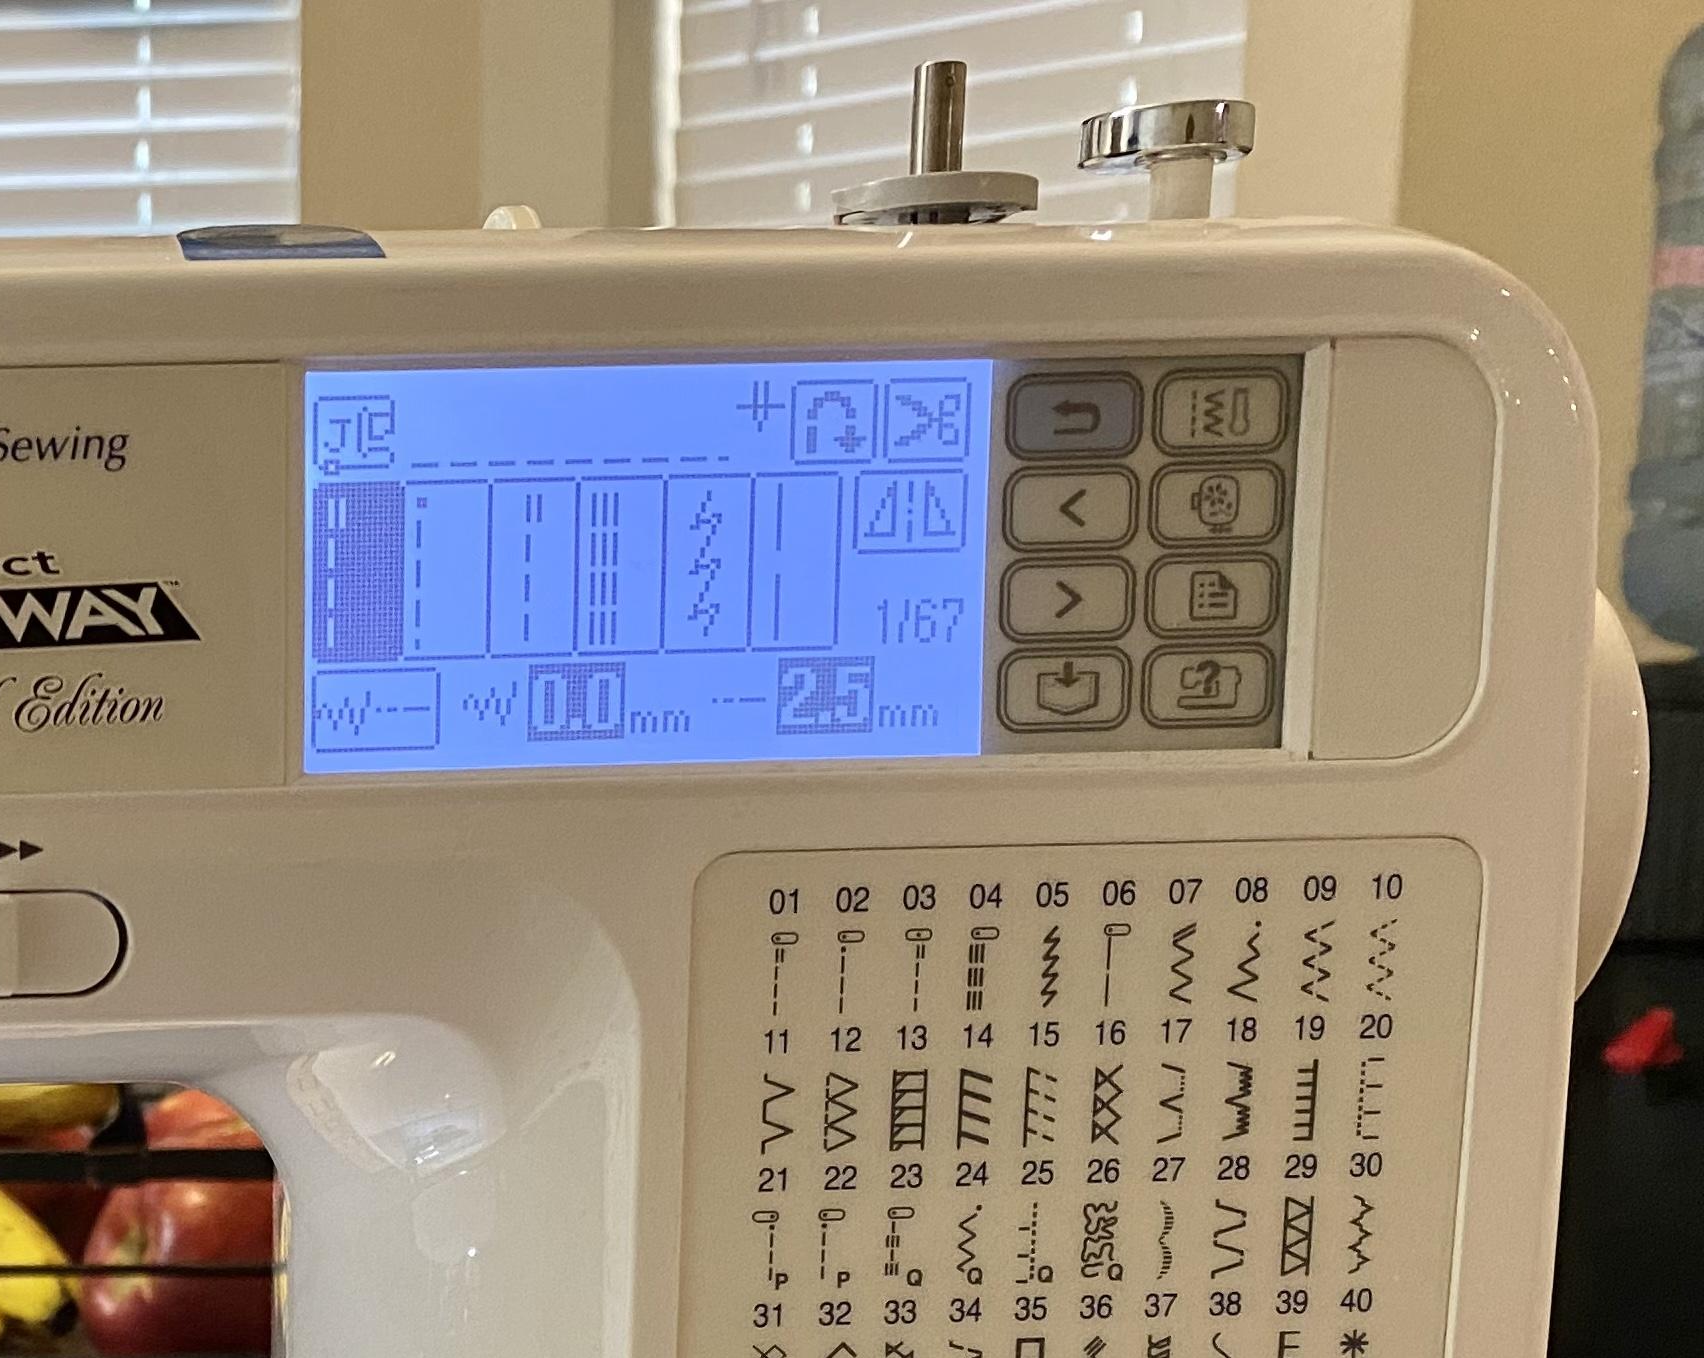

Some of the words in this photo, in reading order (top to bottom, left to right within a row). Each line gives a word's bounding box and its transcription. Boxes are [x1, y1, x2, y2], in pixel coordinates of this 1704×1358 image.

[877, 598, 964, 644] 1/67
[13, 671, 164, 734] Edition
[630, 710, 690, 733] mm
[878, 704, 939, 727] mm
[769, 887, 800, 916] 01
[835, 886, 871, 914] 02
[902, 883, 937, 911] 03
[969, 882, 1004, 910] 04
[1035, 880, 1070, 909] 05
[1102, 879, 1137, 907] 06
[1168, 877, 1204, 905] 07
[1235, 876, 1269, 904] 08
[1303, 874, 1338, 902] 09
[1371, 873, 1403, 900] 10
[763, 1028, 789, 1055] 11
[830, 1026, 863, 1053] 12
[896, 1024, 928, 1051] 13
[963, 1022, 995, 1049] 14
[1028, 1021, 1060, 1048] 15
[1095, 1019, 1127, 1046] 16
[1160, 1017, 1193, 1045] 17
[1226, 1016, 1258, 1043] 18
[1295, 1013, 1326, 1042] 19
[1358, 1013, 1394, 1040] 20
[757, 1166, 788, 1193] 21
[823, 1164, 858, 1191] 22
[889, 1162, 924, 1189] 23
[955, 1160, 990, 1188] 24
[1020, 1159, 1055, 1186] 25
[1086, 1157, 1121, 1185] 26
[1151, 1156, 1187, 1183] 27
[1216, 1154, 1251, 1181] 28
[1283, 1152, 1318, 1180] 29
[1349, 1151, 1383, 1178] 30
[774, 1271, 789, 1290] P
[836, 1270, 851, 1289] P
[906, 1268, 924, 1287] Q
[966, 1267, 983, 1286] Q
[1037, 1265, 1054, 1283] Q
[1107, 1263, 1124, 1281] Q
[752, 1302, 783, 1329] 31
[818, 1300, 853, 1327] 32
[883, 1298, 918, 1325] 33
[948, 1296, 983, 1323] 34
[1013, 1295, 1048, 1322] 35
[1079, 1293, 1114, 1320] 36
[1143, 1292, 1179, 1319] 37
[1208, 1290, 1242, 1317] 38
[1275, 1288, 1309, 1315] 39
[1339, 1287, 1374, 1313] 40
